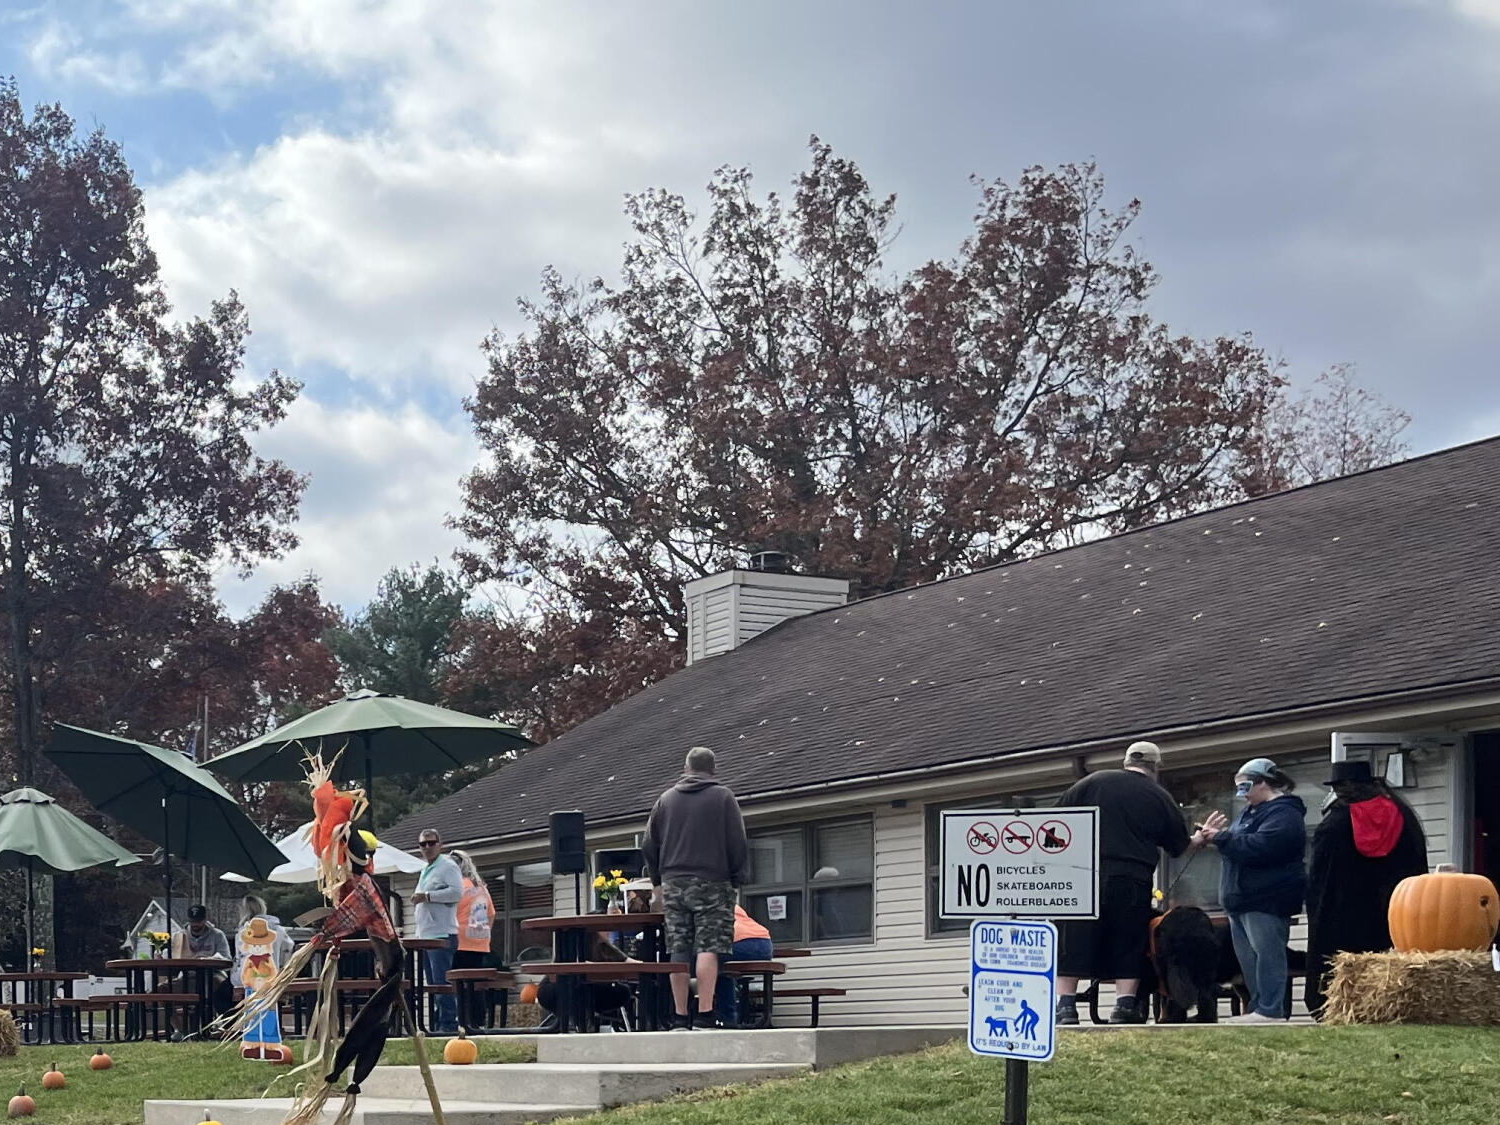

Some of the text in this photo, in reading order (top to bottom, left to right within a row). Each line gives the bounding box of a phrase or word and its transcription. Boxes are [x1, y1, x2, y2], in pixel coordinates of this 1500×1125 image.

[996, 866, 1046, 875] BICYCLES
[958, 864, 990, 907] NO
[996, 882, 1073, 890] SKATEBOARDS
[996, 897, 1078, 906] ROLLERBLADES
[981, 927, 1047, 947] DOG WASTE
